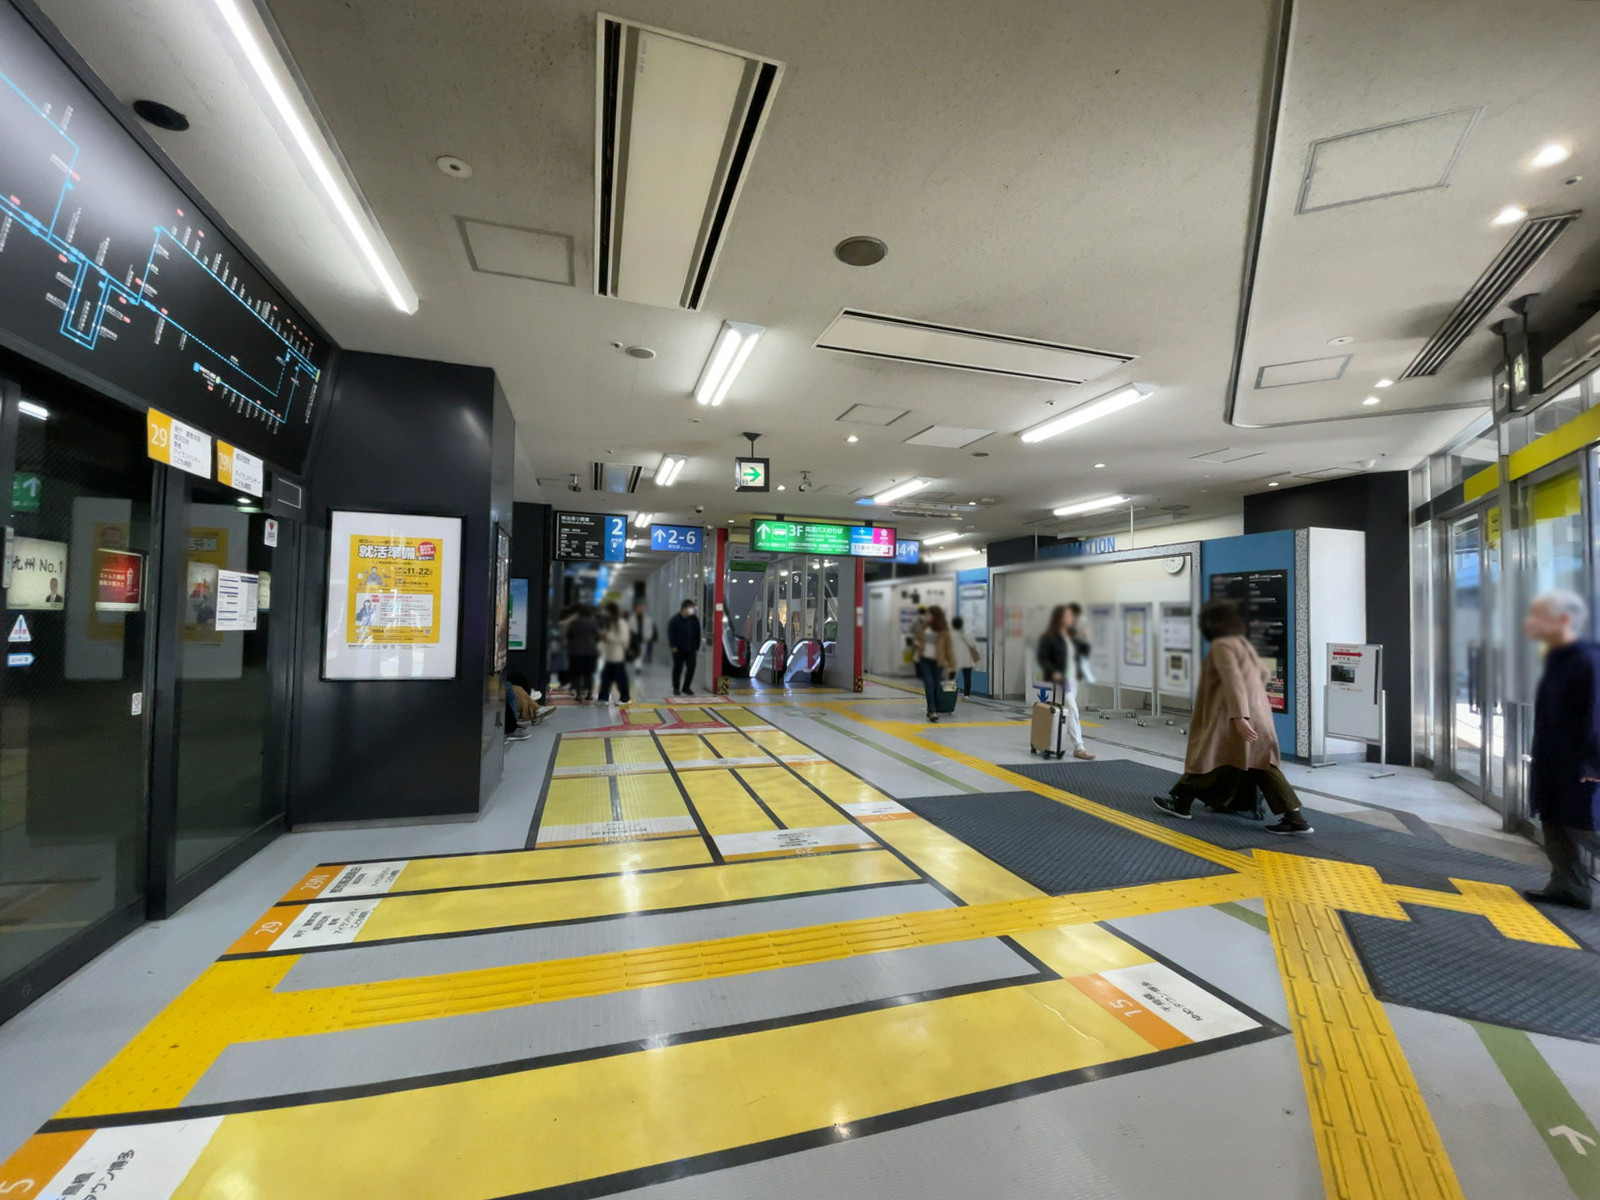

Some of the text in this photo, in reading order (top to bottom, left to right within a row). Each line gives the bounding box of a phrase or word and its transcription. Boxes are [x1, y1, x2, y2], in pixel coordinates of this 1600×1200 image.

[150, 424, 168, 448] 29
[612, 519, 623, 535] 2
[789, 525, 803, 537] 3F
[668, 530, 696, 545] 2-6
[254, 921, 284, 937] 29
[1108, 1000, 1142, 1018] 15
